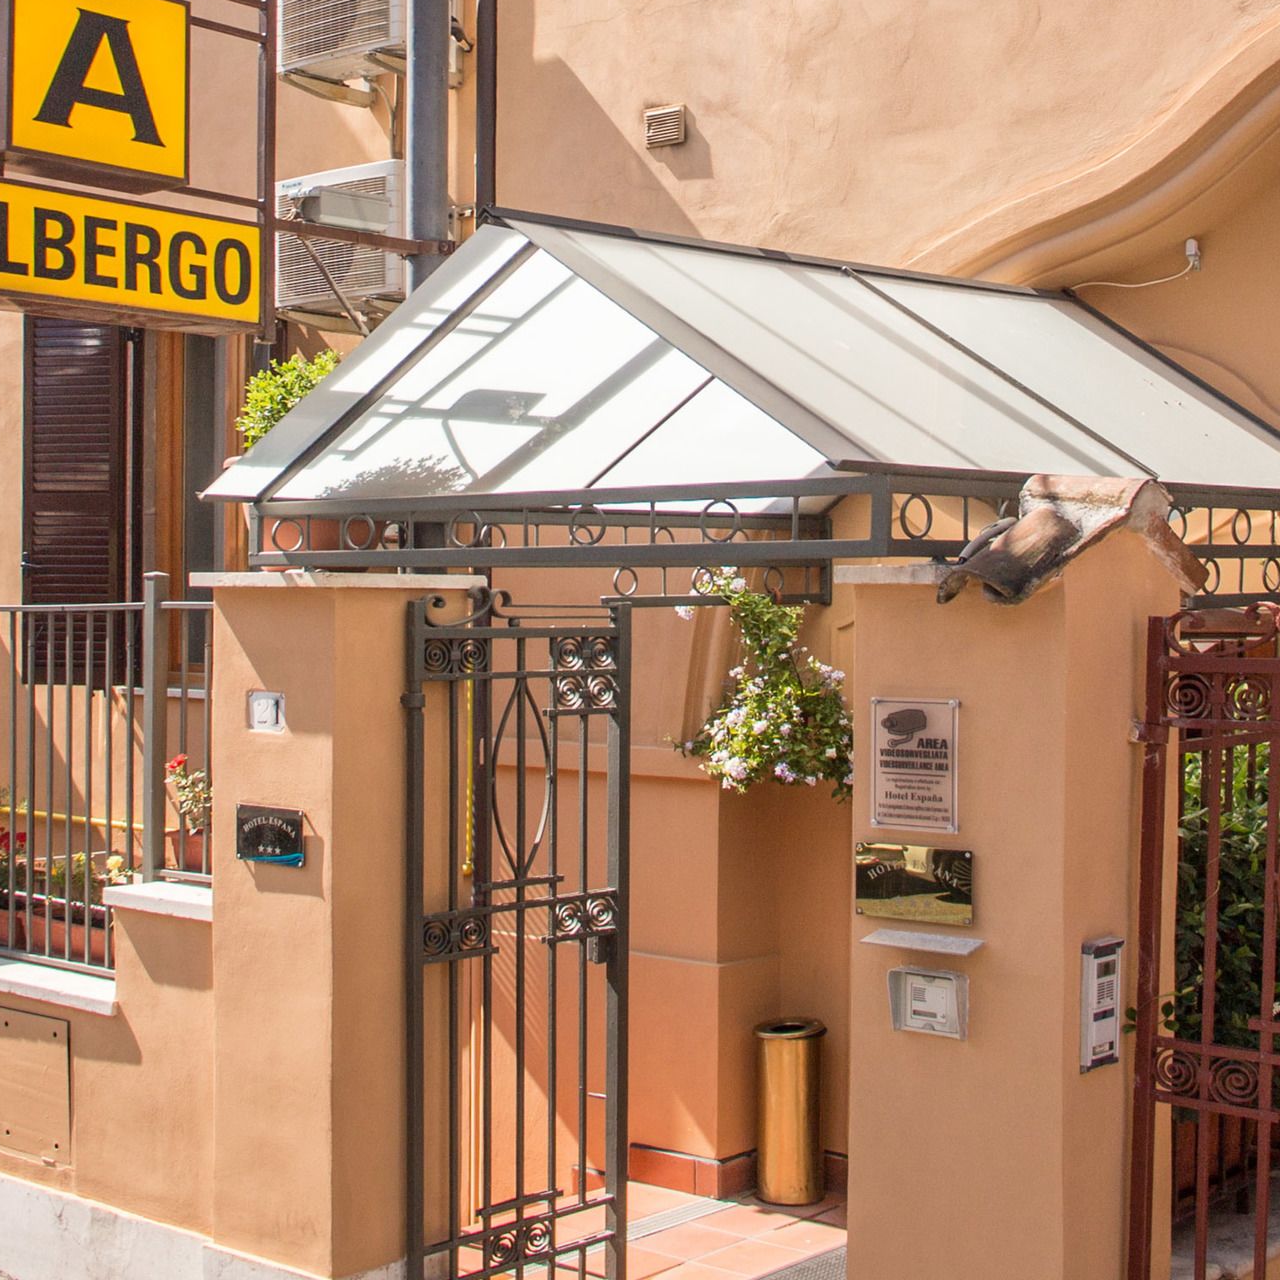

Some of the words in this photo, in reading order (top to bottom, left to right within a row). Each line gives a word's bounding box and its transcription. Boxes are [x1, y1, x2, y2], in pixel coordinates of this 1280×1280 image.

[917, 738, 948, 750] AREA
[880, 748, 948, 760] VIDEOSORVEGLIATA
[885, 791, 908, 801] Hotel
[910, 793, 943, 804] España
[243, 816, 268, 832] HOTEL
